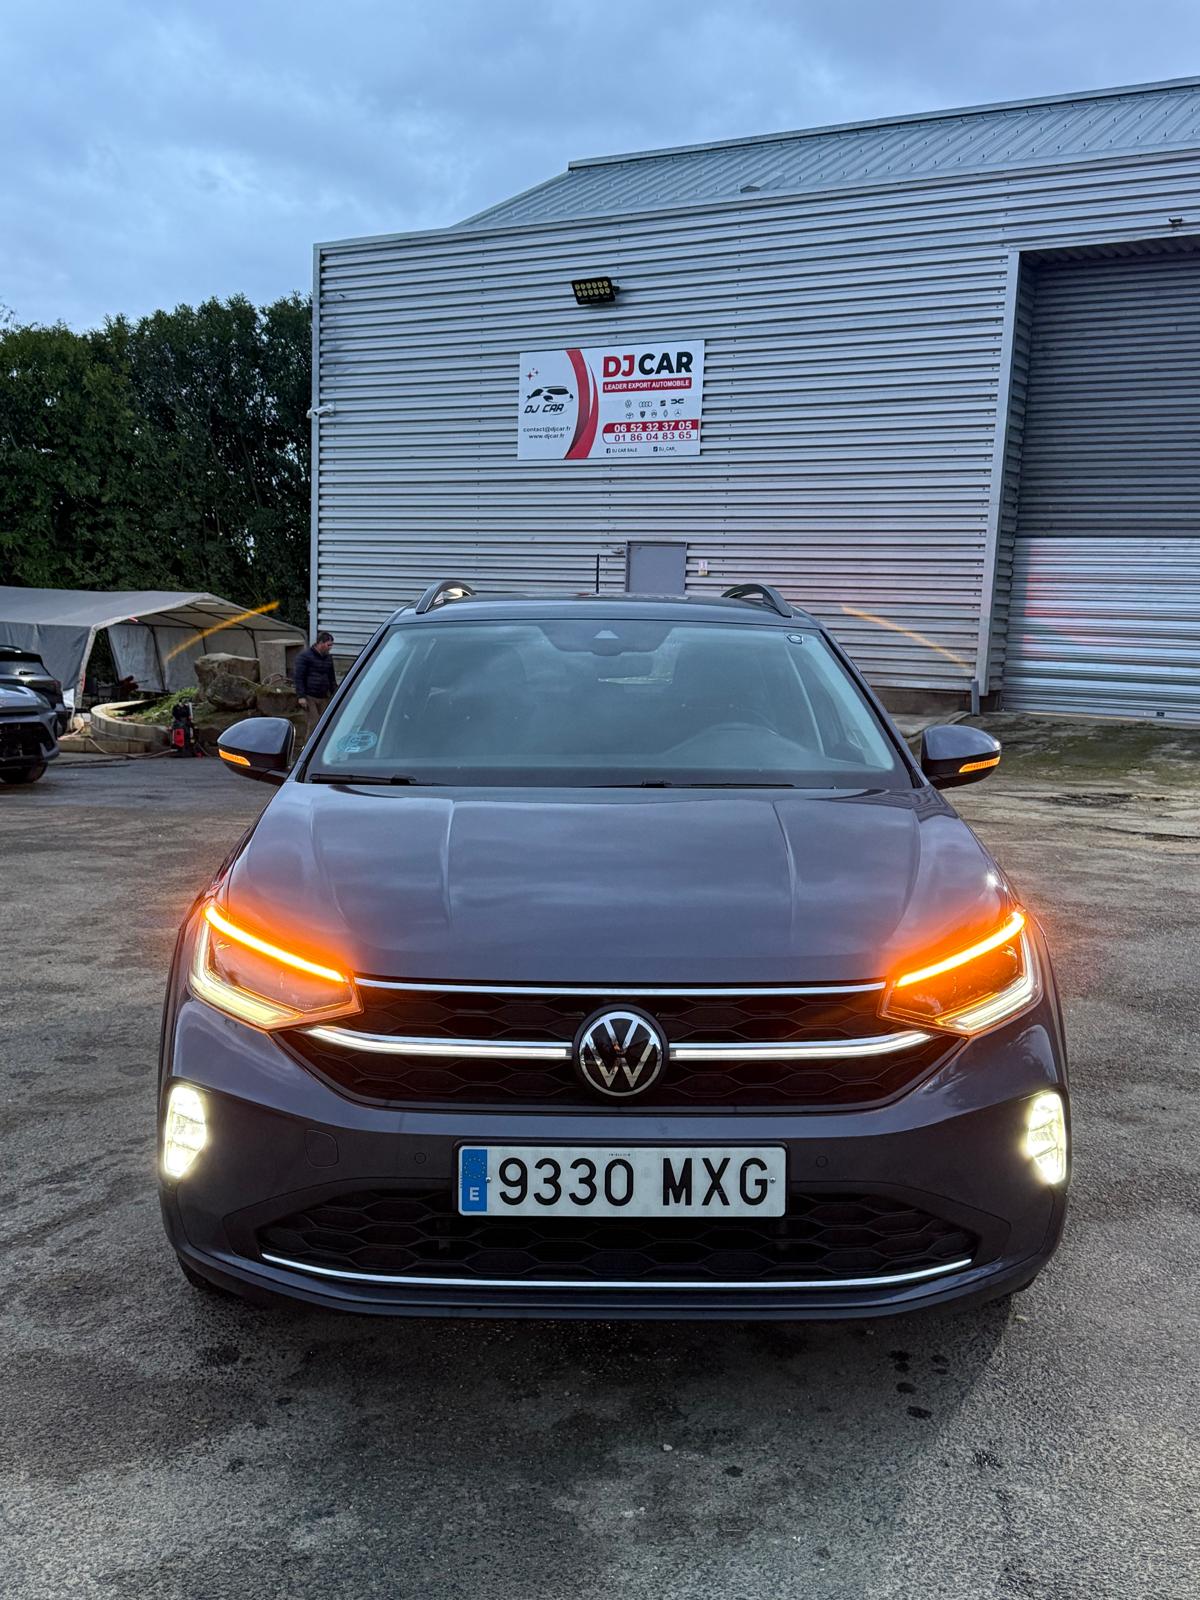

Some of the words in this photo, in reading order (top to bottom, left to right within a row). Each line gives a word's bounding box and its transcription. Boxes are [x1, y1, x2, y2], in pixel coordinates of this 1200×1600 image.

[603, 355, 635, 377] DJ
[638, 351, 693, 375] CAR
[604, 383, 627, 391] LEADER
[628, 382, 651, 390] EXPORT
[651, 379, 690, 388] AUTOMOBILE
[524, 404, 540, 414] DJ
[542, 403, 565, 413] CAR
[614, 424, 627, 433] 06
[630, 423, 643, 432] 52
[646, 422, 659, 431] 32
[662, 421, 675, 431] 37
[678, 420, 692, 430] 05
[614, 434, 626, 442] 01
[630, 433, 643, 441] 86
[646, 432, 659, 440] 04
[662, 431, 675, 440] 83
[678, 431, 692, 439] 65
[498, 1157, 634, 1207] 9330
[662, 1157, 768, 1207] MXG
[469, 1186, 480, 1201] E
